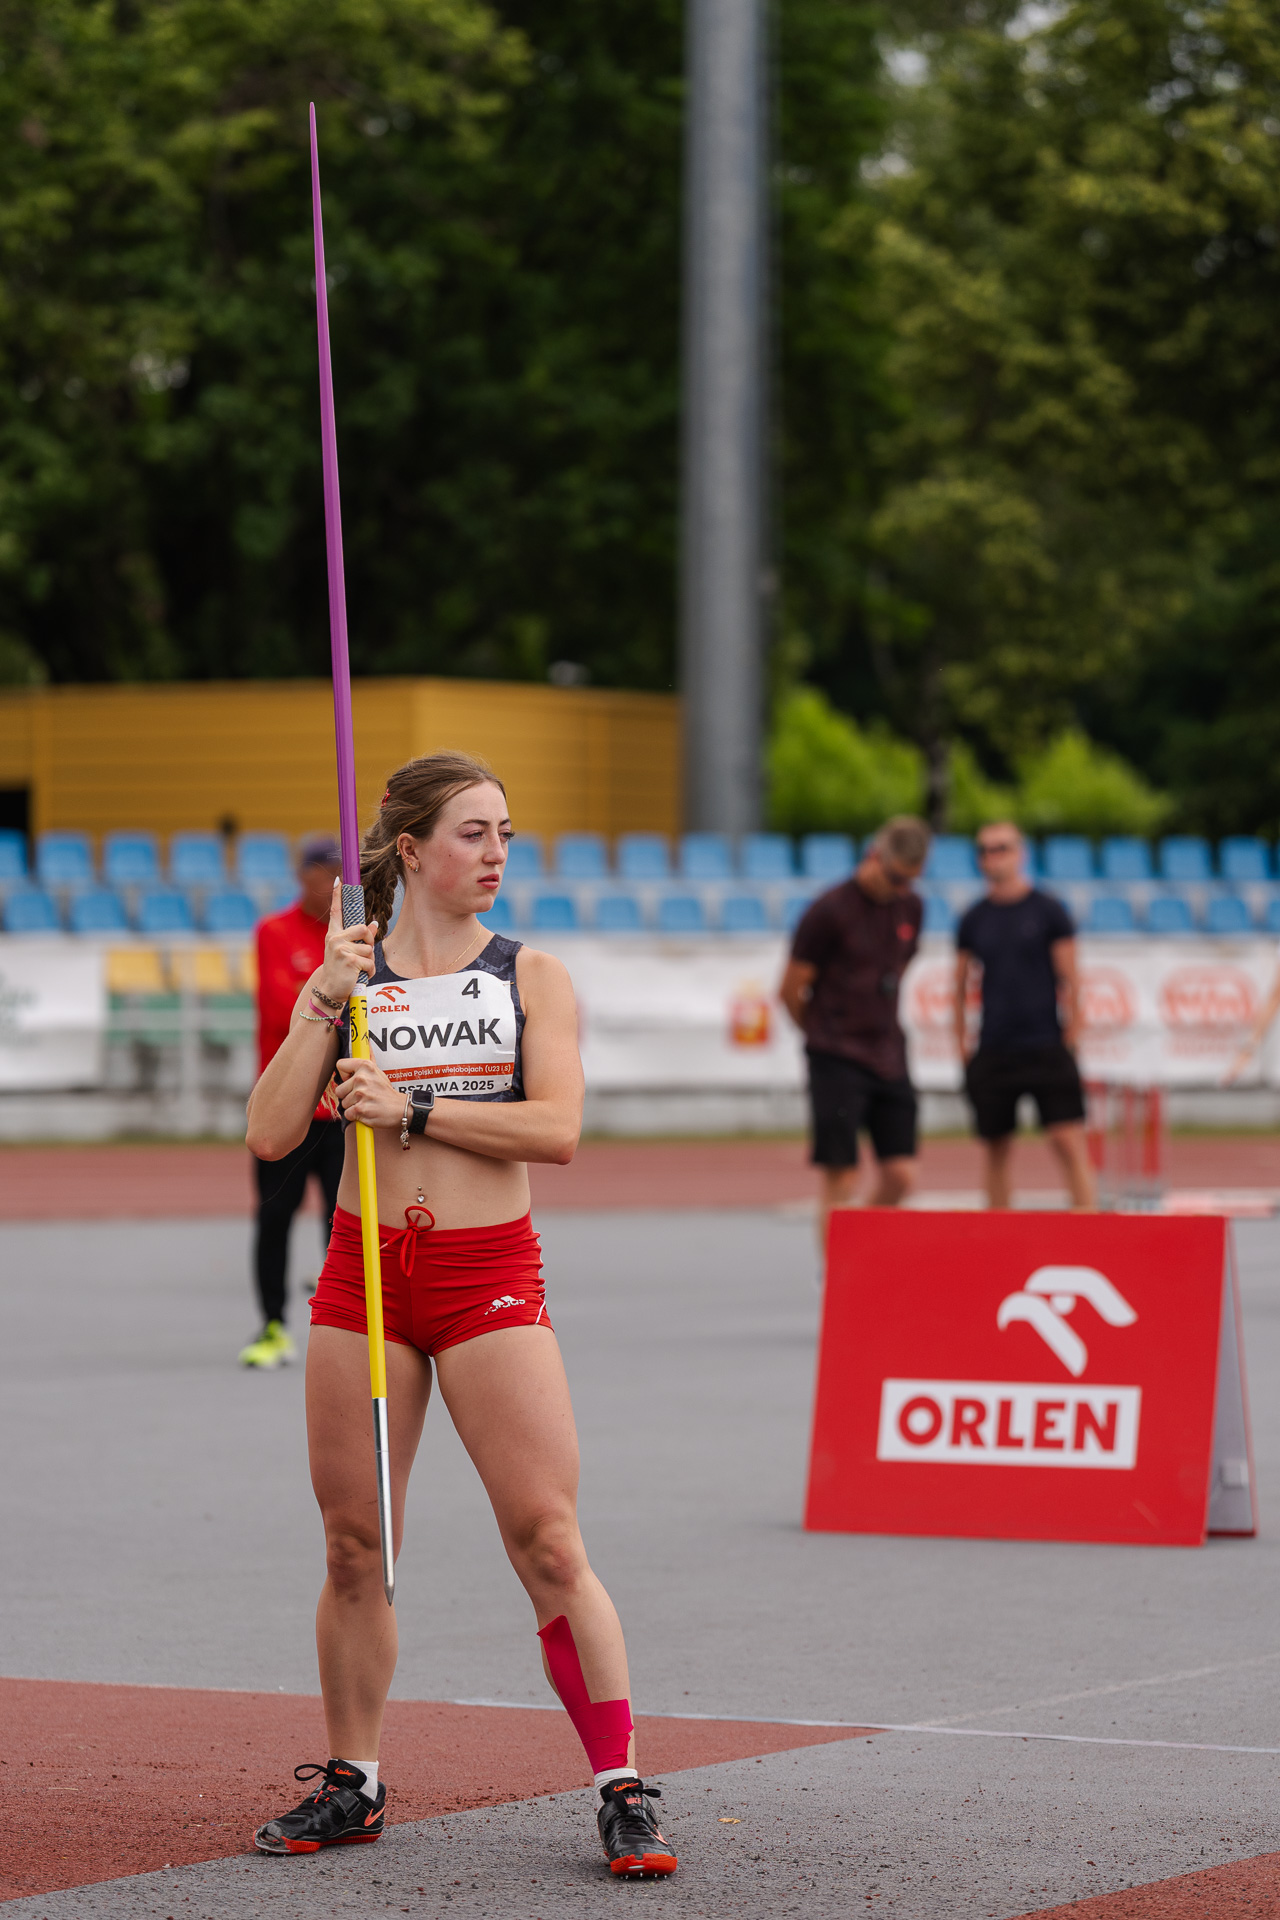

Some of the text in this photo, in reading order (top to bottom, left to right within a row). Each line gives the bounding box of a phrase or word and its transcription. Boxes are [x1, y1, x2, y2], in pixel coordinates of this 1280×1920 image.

[461, 978, 481, 999] 4
[370, 1004, 410, 1014] ORLEN
[368, 1018, 502, 1052] NOWAK
[413, 1068, 434, 1077] Polski
[442, 1066, 484, 1075] wielobojach
[485, 1065, 500, 1073] (U23
[398, 1080, 494, 1094] RSZAWA 2025
[898, 1395, 1119, 1454] ORLEN
